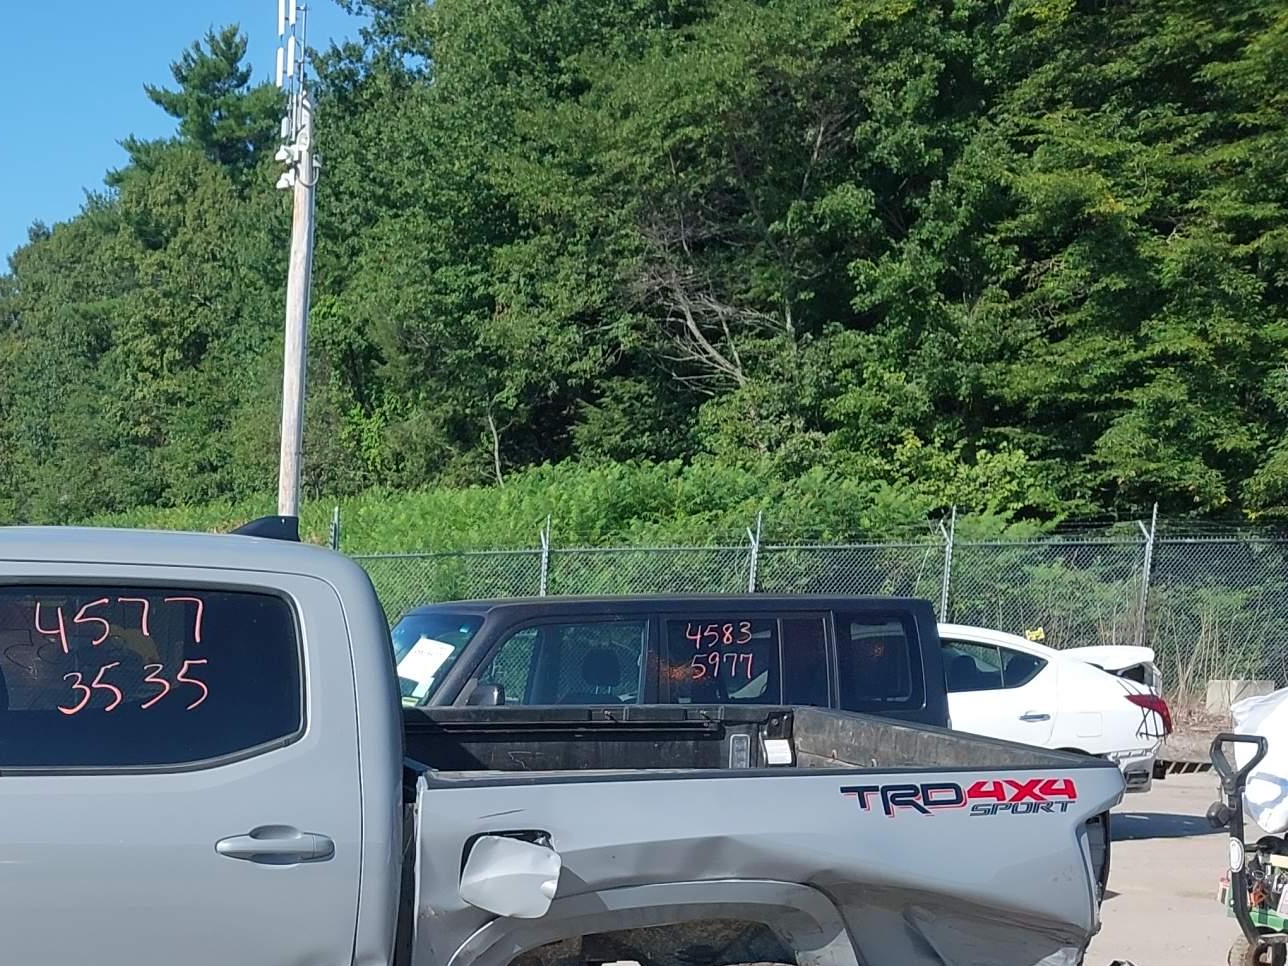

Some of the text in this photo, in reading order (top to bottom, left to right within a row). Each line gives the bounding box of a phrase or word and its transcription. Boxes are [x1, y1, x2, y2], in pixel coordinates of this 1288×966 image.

[34, 597, 205, 654] 4577
[686, 621, 752, 649] 4583
[691, 651, 753, 679] 5977
[57, 659, 209, 715] 3535
[840, 782, 967, 818] TRD
[969, 800, 1076, 817] SPORT
